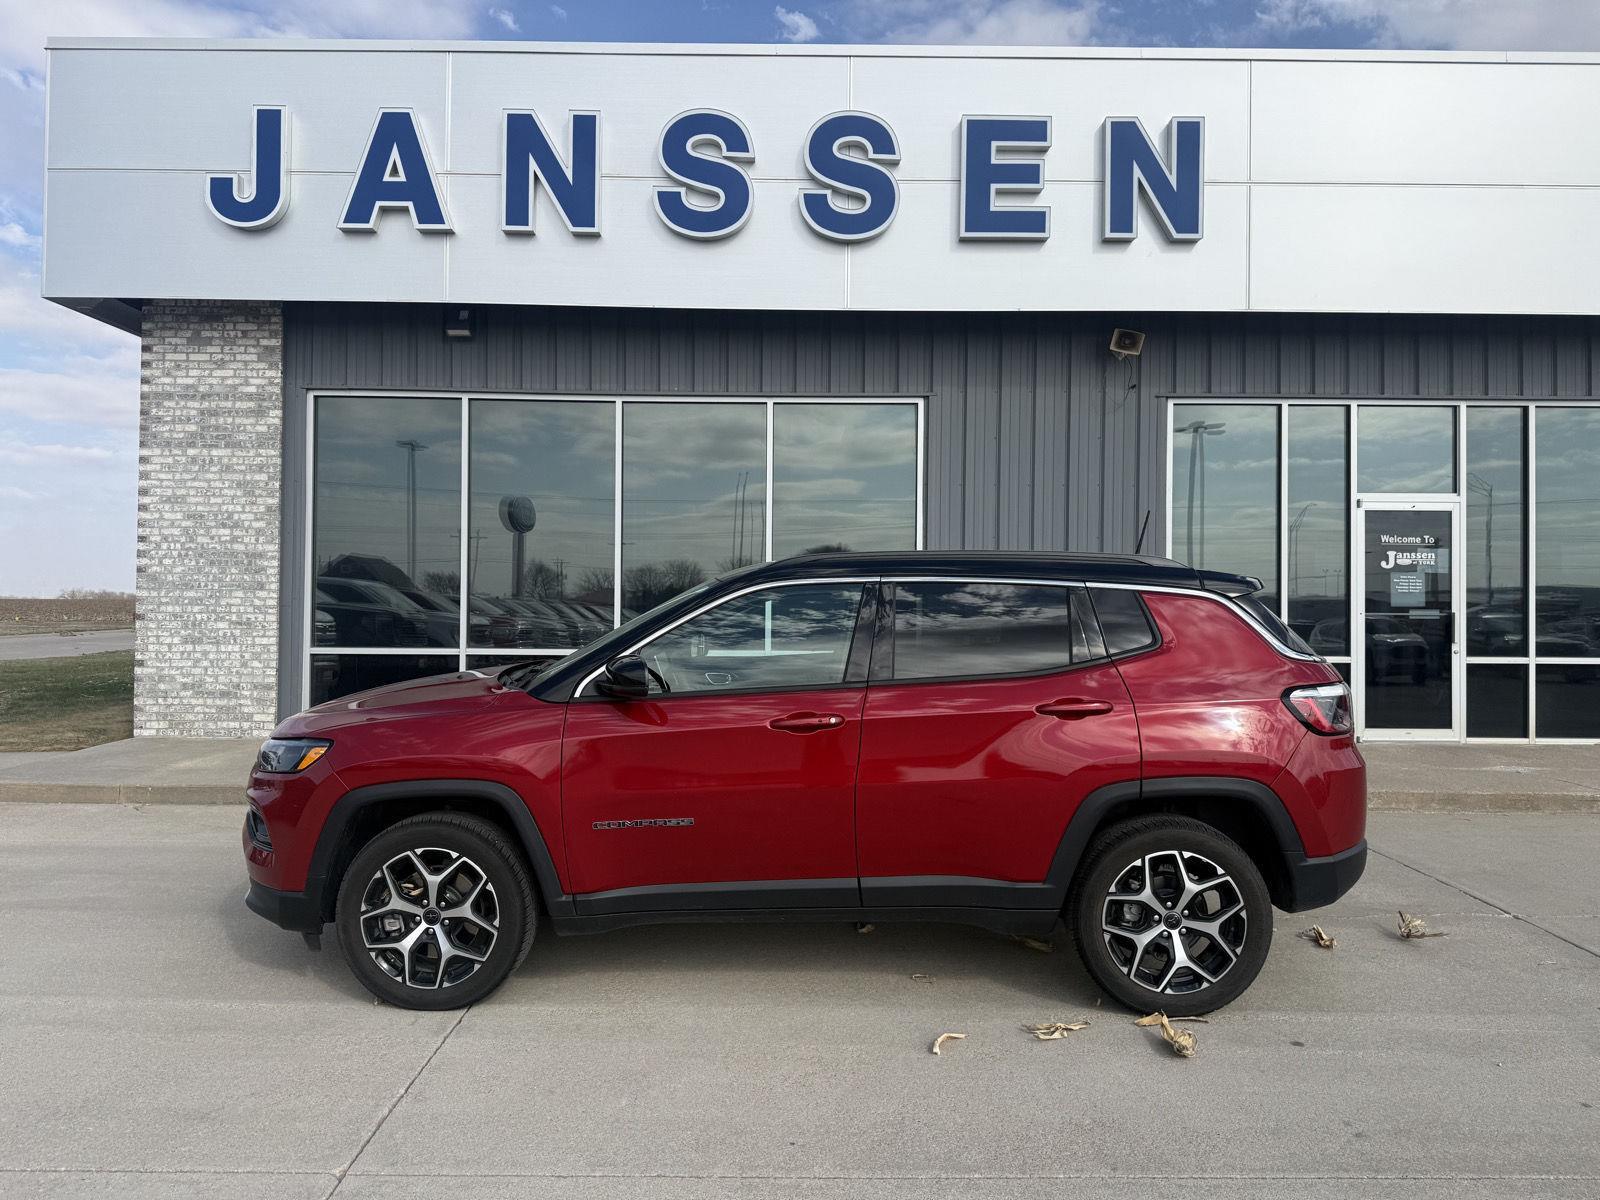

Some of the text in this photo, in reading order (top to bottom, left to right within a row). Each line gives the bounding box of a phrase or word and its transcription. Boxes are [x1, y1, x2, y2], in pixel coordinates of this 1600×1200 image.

[205, 104, 1206, 243] JANSSEN
[1380, 534, 1435, 544] Welcome To
[1380, 550, 1436, 569] Janssen
[592, 818, 695, 830] COMPASS
